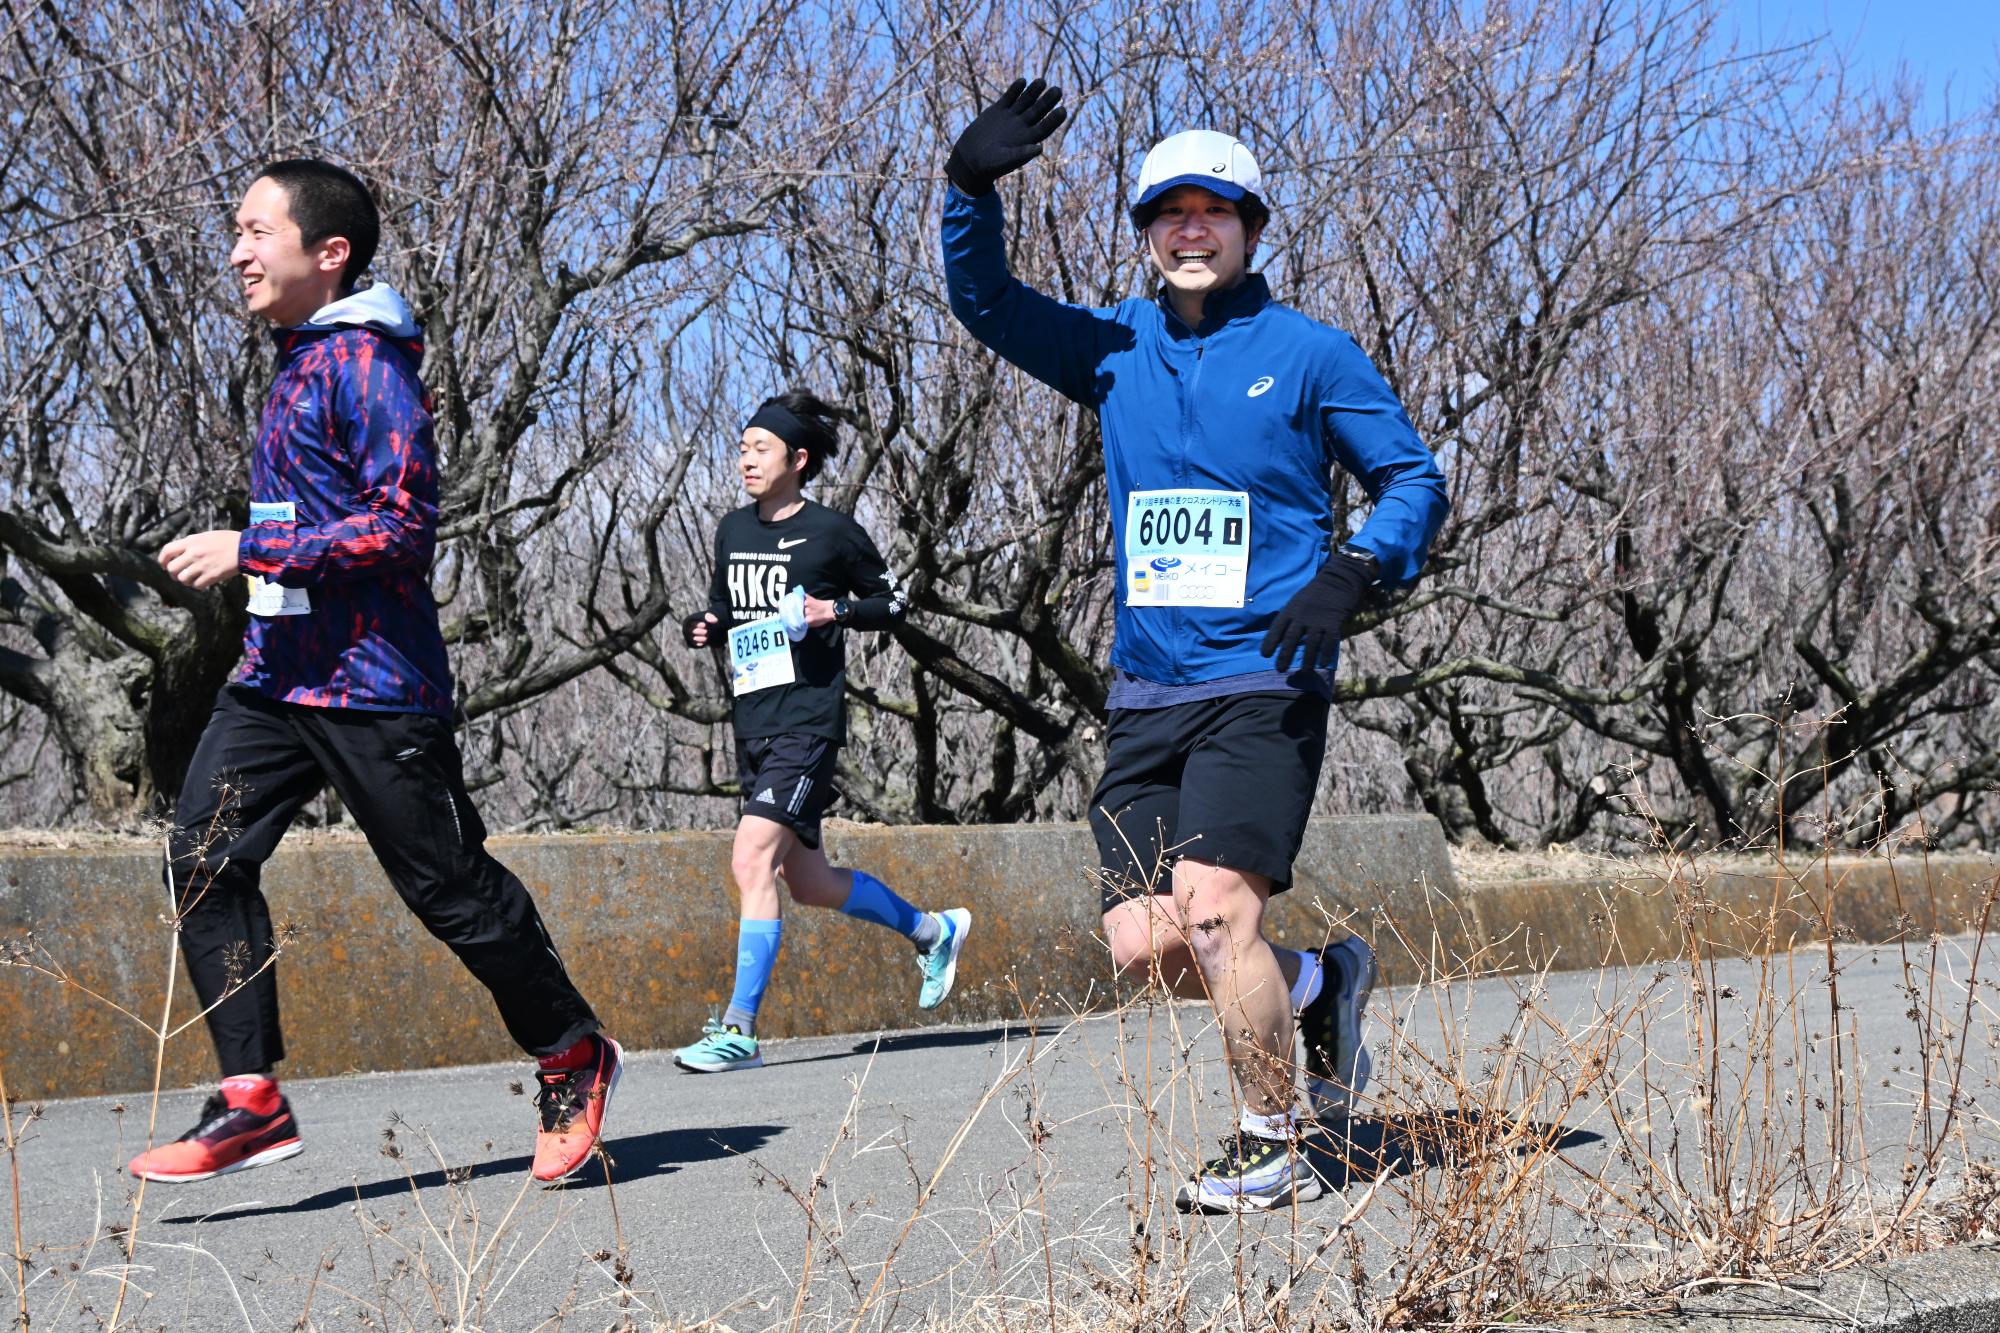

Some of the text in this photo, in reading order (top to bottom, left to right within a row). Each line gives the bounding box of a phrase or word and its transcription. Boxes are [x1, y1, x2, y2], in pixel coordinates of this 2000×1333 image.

[1140, 508, 1213, 546] 6004
[1185, 562, 1242, 576] メイコー
[728, 564, 788, 609] HKG
[736, 629, 769, 659] 6246
